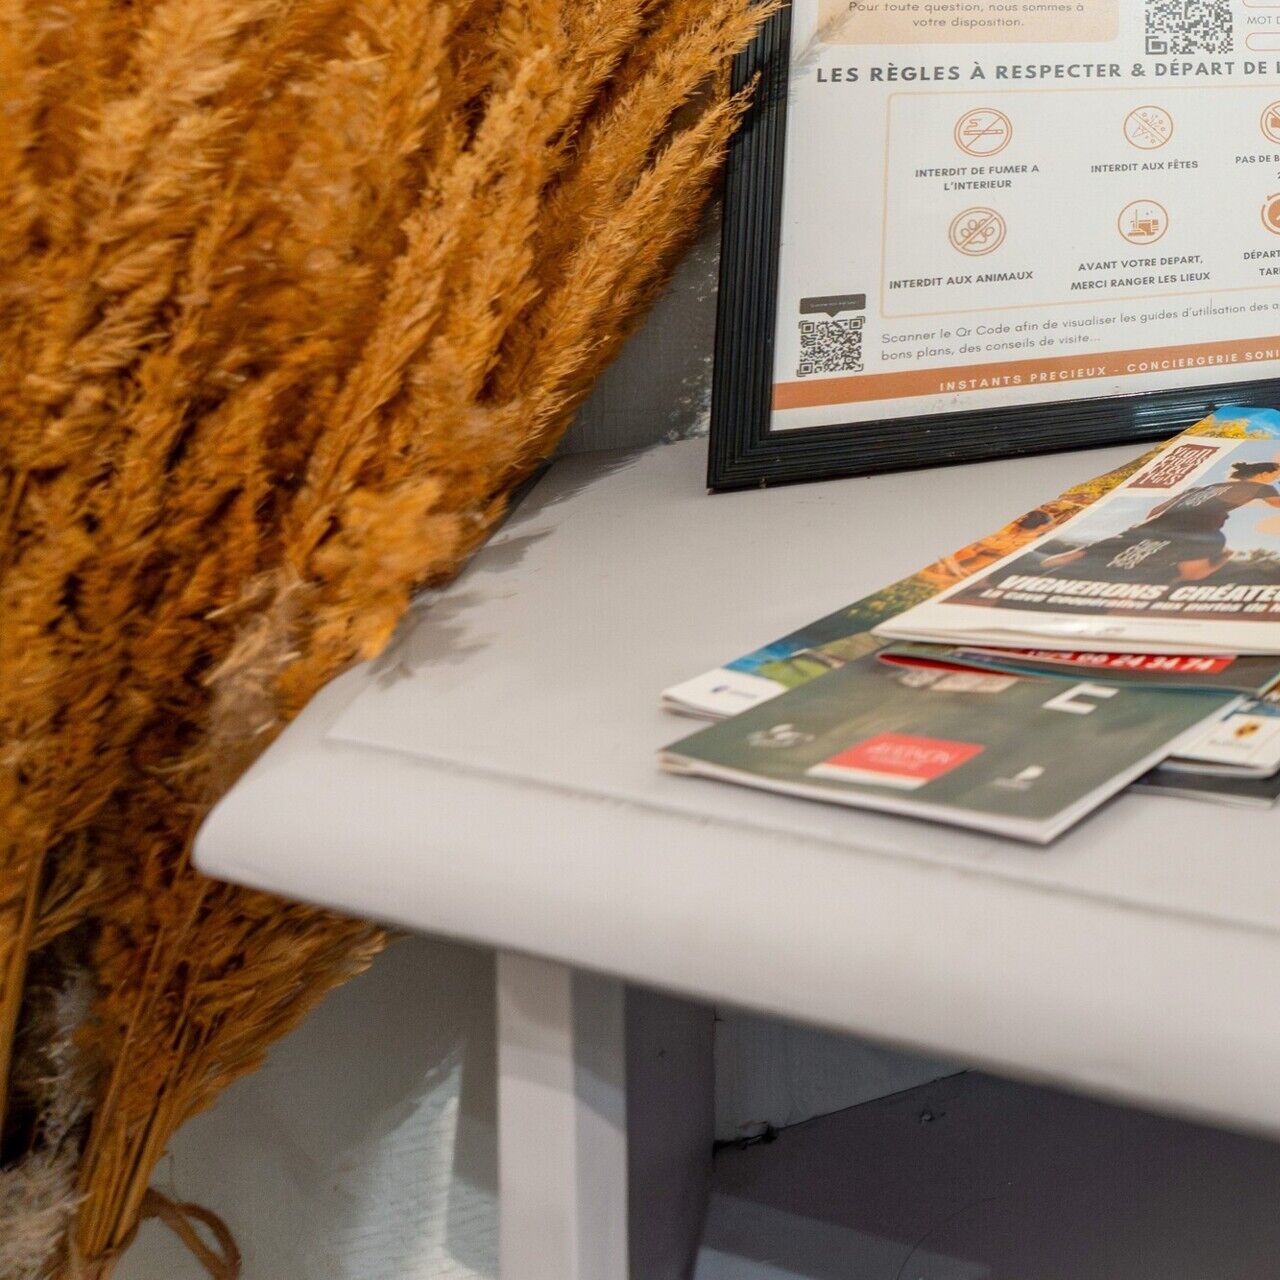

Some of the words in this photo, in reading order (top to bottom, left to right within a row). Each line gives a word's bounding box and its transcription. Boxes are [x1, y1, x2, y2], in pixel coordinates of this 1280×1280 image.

[848, 1, 879, 12] Pour
[884, 1, 920, 12] toute
[924, 2, 984, 15] question,
[989, 3, 1018, 12] nous
[1022, 4, 1072, 12] sommes
[1076, 2, 1084, 12] à
[913, 18, 946, 27] votre
[951, 16, 1024, 29] disposition.
[1246, 15, 1274, 25] MOT
[816, 67, 859, 83] LES
[869, 62, 960, 82] RÈGLES
[970, 60, 986, 80] À
[995, 63, 1122, 80] RESPECTER
[1130, 63, 1146, 77] &
[1155, 58, 1235, 77] DÉPART
[1244, 60, 1267, 76] DE
[1091, 161, 1138, 173] INTERDIT
[1141, 161, 1165, 171] AUX
[1167, 158, 1199, 170] FÊTES
[1235, 155, 1255, 164] PAS
[1258, 154, 1272, 163] DE
[915, 167, 967, 178] INTERDIT
[971, 166, 985, 176] DE
[988, 165, 1028, 175] FUMER
[1031, 164, 1040, 173] A
[944, 179, 1012, 191] L'INTERIEUR
[1243, 248, 1280, 260] DÉPART
[1078, 261, 1117, 272] AVANT
[1121, 258, 1157, 269] VOTRE
[1160, 255, 1203, 267] DEPART,
[889, 277, 944, 290] INTERDIT
[946, 274, 973, 286] AUX
[975, 271, 1034, 284] ANIMAUX
[1070, 279, 1107, 291] MERCI
[1110, 276, 1155, 288] RANGER
[1158, 274, 1177, 285] LES
[1180, 271, 1210, 282] LIEUX
[882, 332, 935, 344] Scanner
[940, 329, 951, 339] le
[955, 327, 972, 338] Qr
[976, 323, 1011, 336] Code
[1015, 321, 1038, 333] afin
[1043, 318, 1058, 330] de
[1062, 313, 1116, 328] visualiser
[1120, 311, 1137, 323] les
[1140, 309, 1178, 324] guides
[1249, 301, 1269, 312] des
[881, 348, 913, 361] bons
[917, 345, 955, 360] plans,
[959, 341, 981, 354] des
[985, 337, 1035, 351] conseils
[1039, 335, 1055, 347] de
[940, 374, 1022, 392] INSTANTS
[1030, 366, 1106, 383] PRECIEUX
[1127, 352, 1238, 373] CONCIERGERIE
[997, 574, 1170, 599] VIGNERONS
